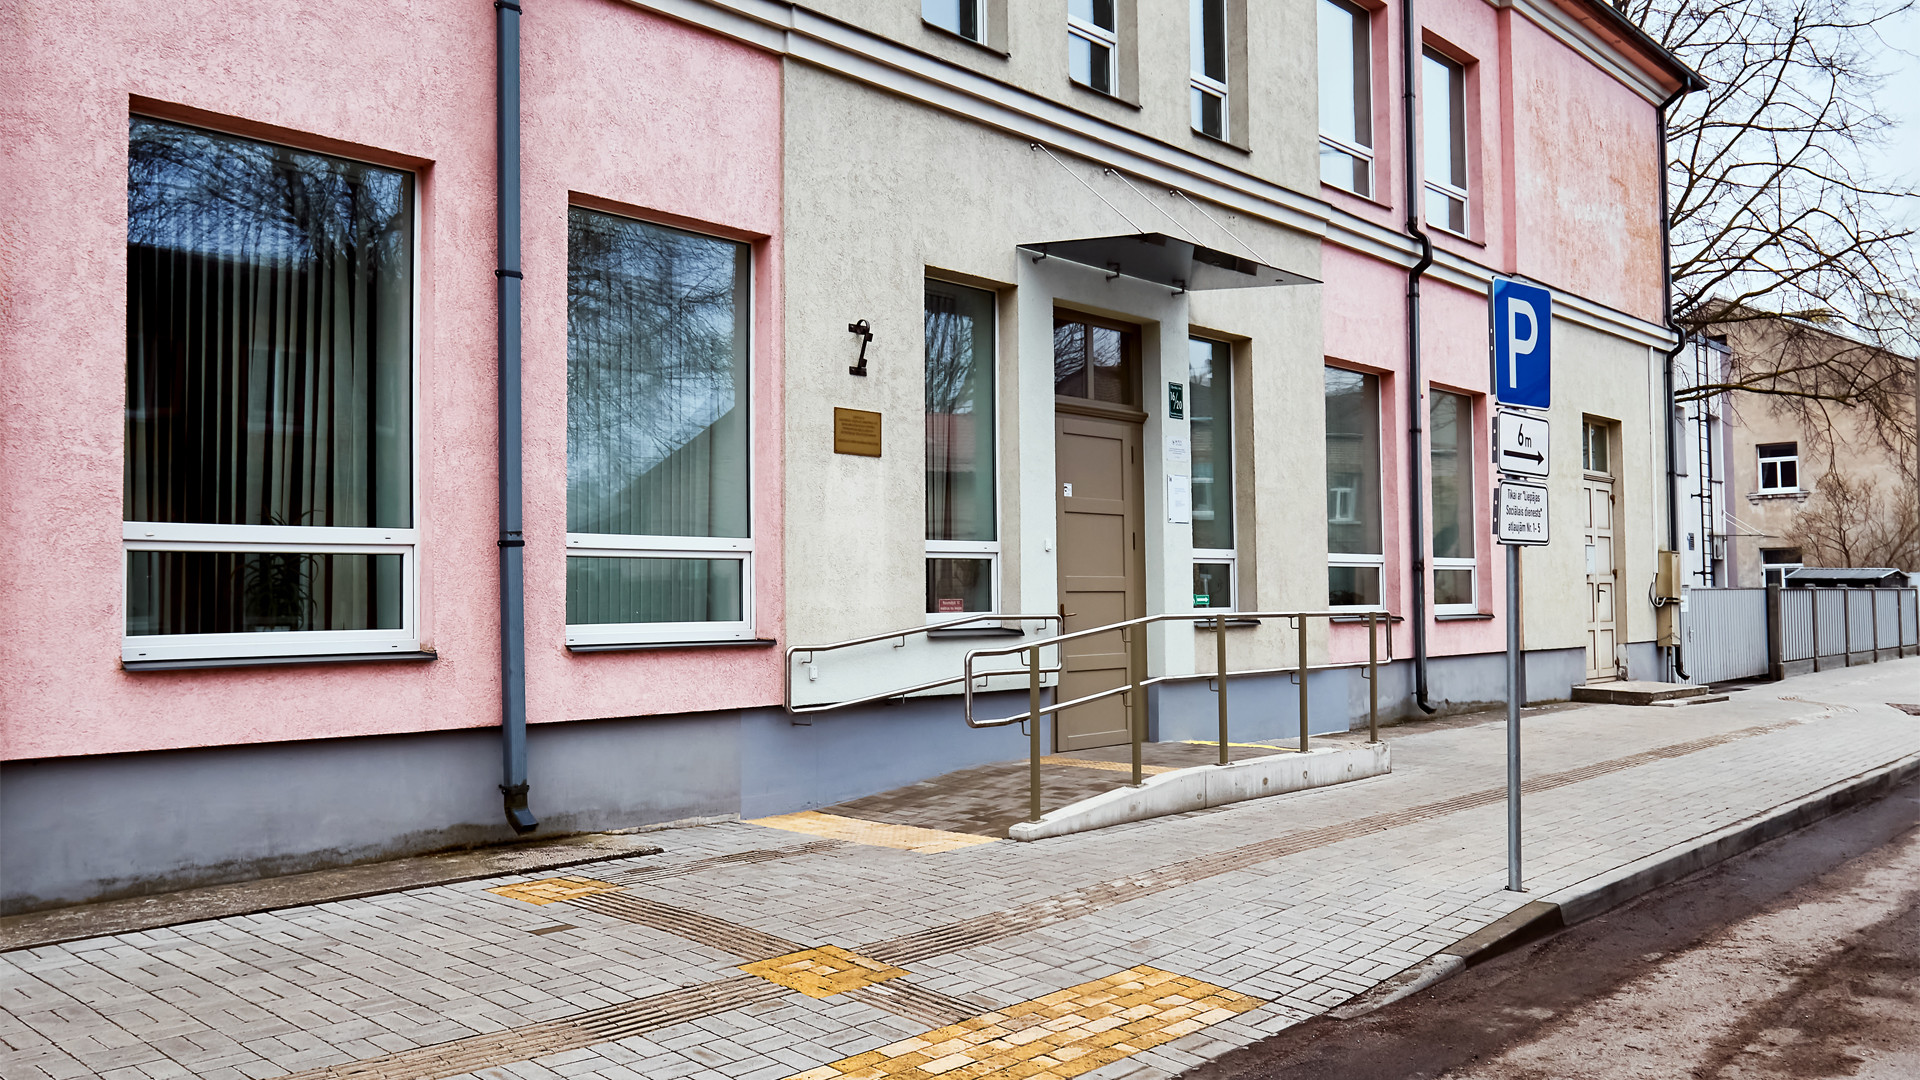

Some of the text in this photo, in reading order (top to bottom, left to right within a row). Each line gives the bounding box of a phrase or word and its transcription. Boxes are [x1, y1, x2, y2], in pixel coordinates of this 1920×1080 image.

[1508, 297, 1538, 389] P
[1507, 488, 1516, 500] Tikai
[1517, 492, 1522, 500] ar
